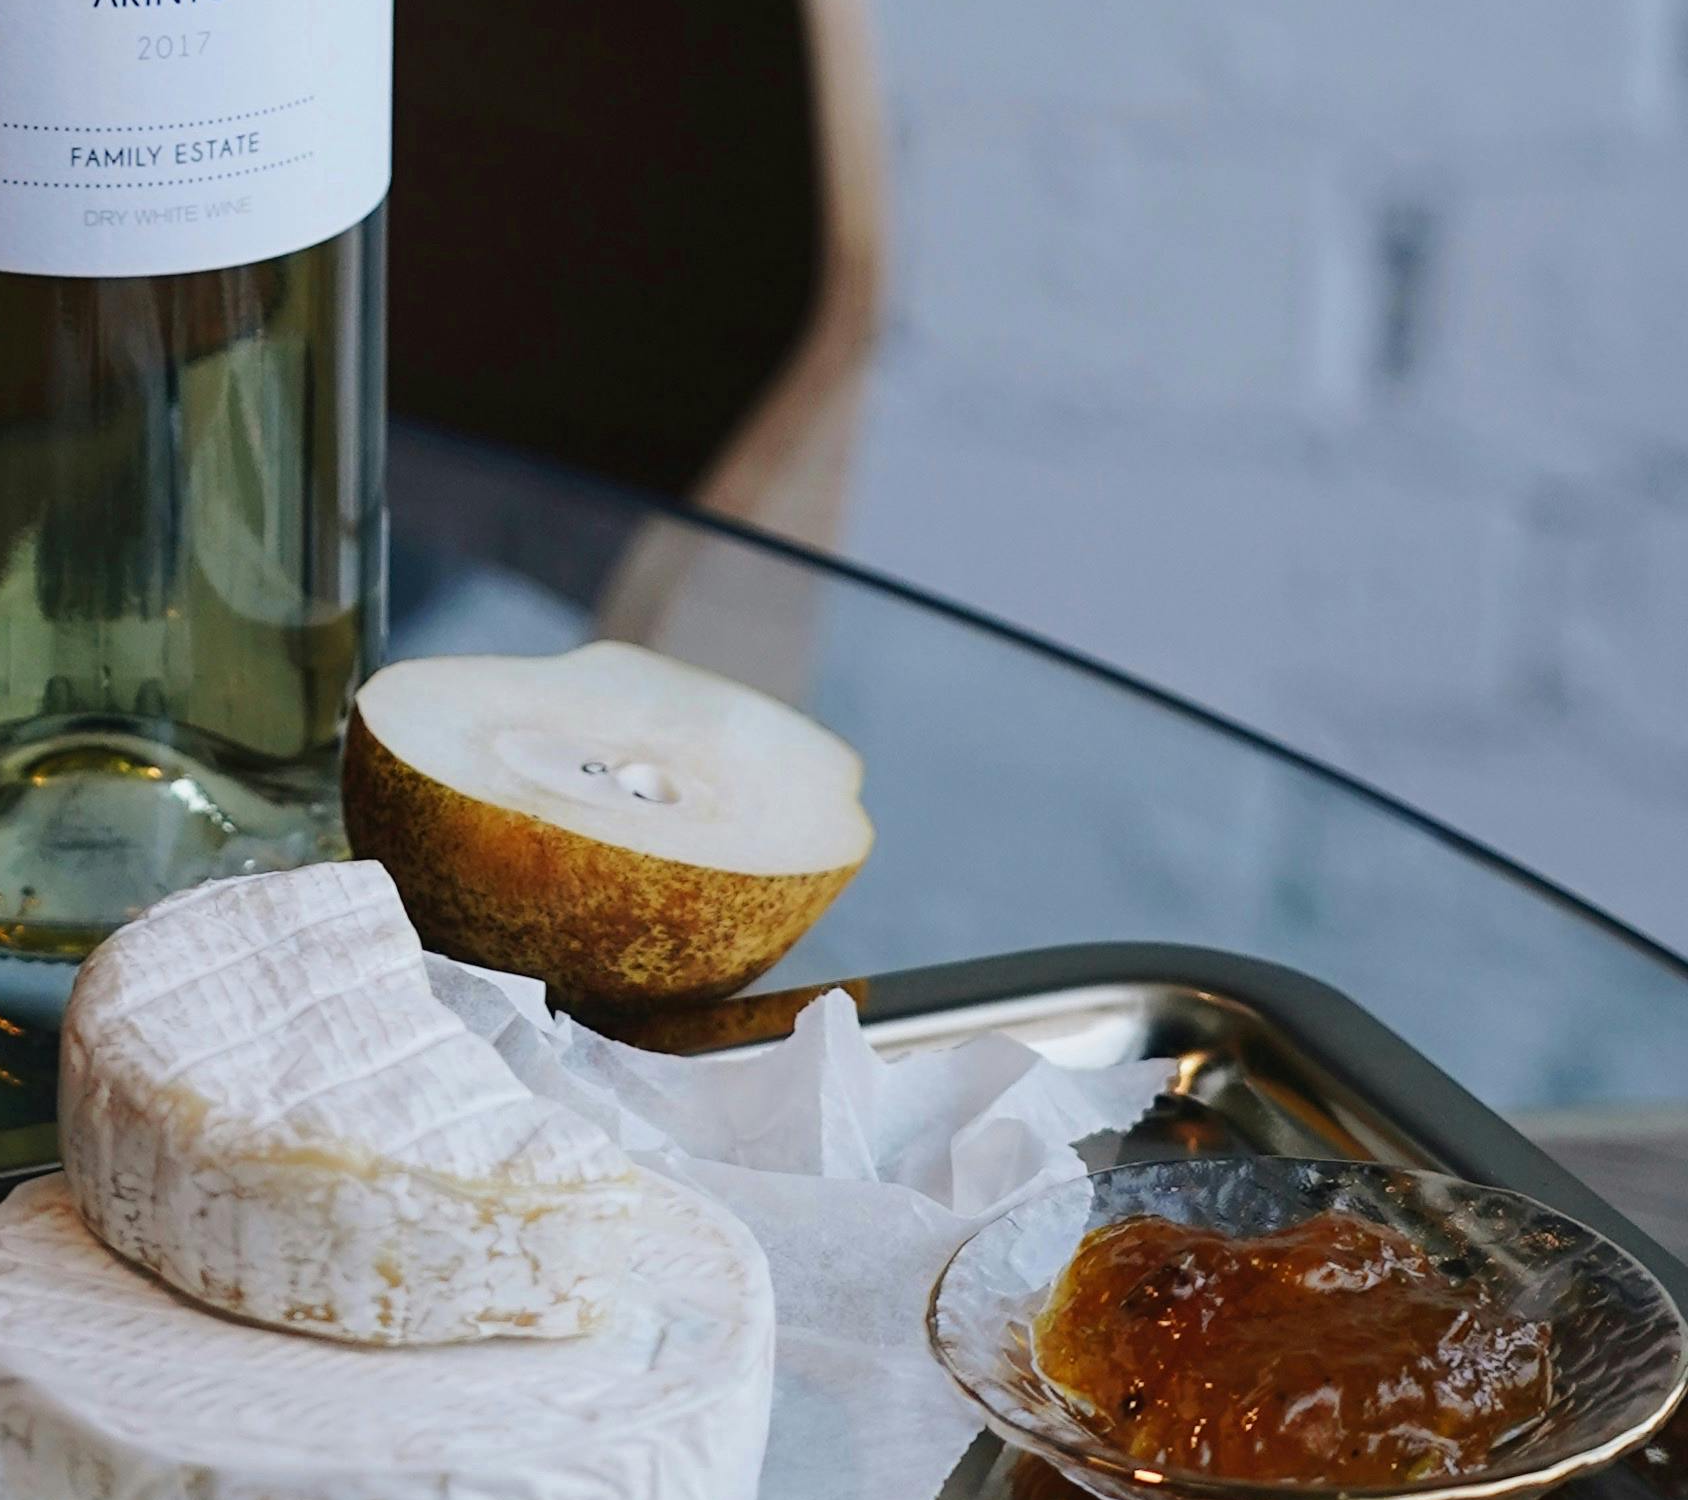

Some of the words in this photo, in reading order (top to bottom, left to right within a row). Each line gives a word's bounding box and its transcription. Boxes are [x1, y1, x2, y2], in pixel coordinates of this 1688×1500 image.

[136, 30, 212, 61] 2017
[69, 145, 163, 168] FAMILY
[174, 131, 261, 165] ESTATE
[82, 209, 128, 227] DRY
[135, 204, 198, 226] WHITE
[205, 196, 254, 218] WINE
